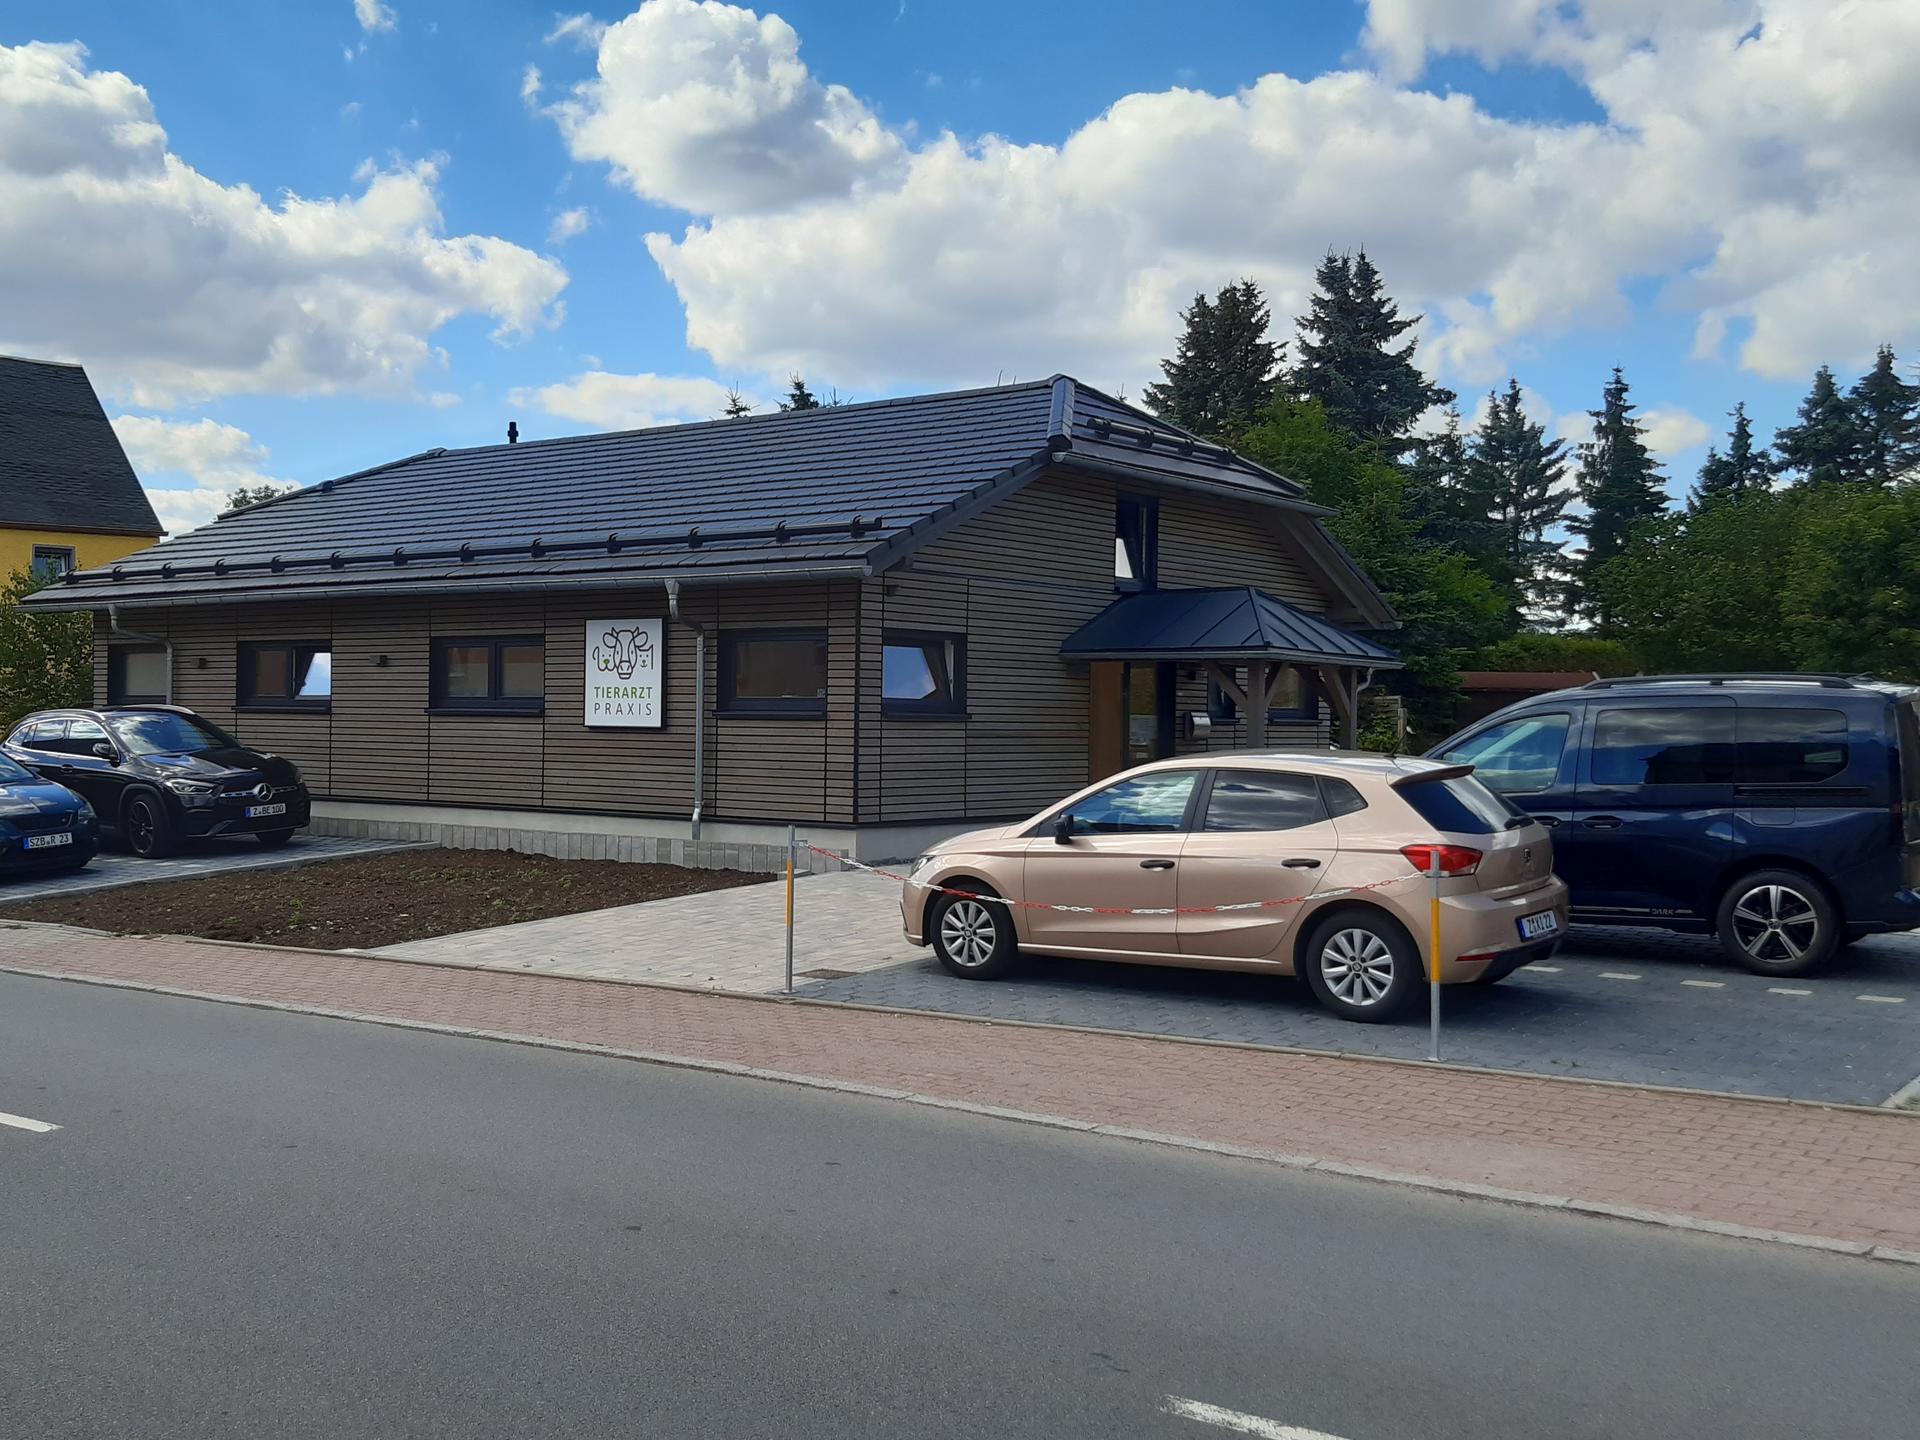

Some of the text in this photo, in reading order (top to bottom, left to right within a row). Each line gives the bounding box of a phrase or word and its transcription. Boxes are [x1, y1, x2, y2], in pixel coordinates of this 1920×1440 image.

[594, 686, 653, 699] TIERARZT
[594, 702, 652, 716] PRAXIS
[29, 834, 69, 847] SZB R 23
